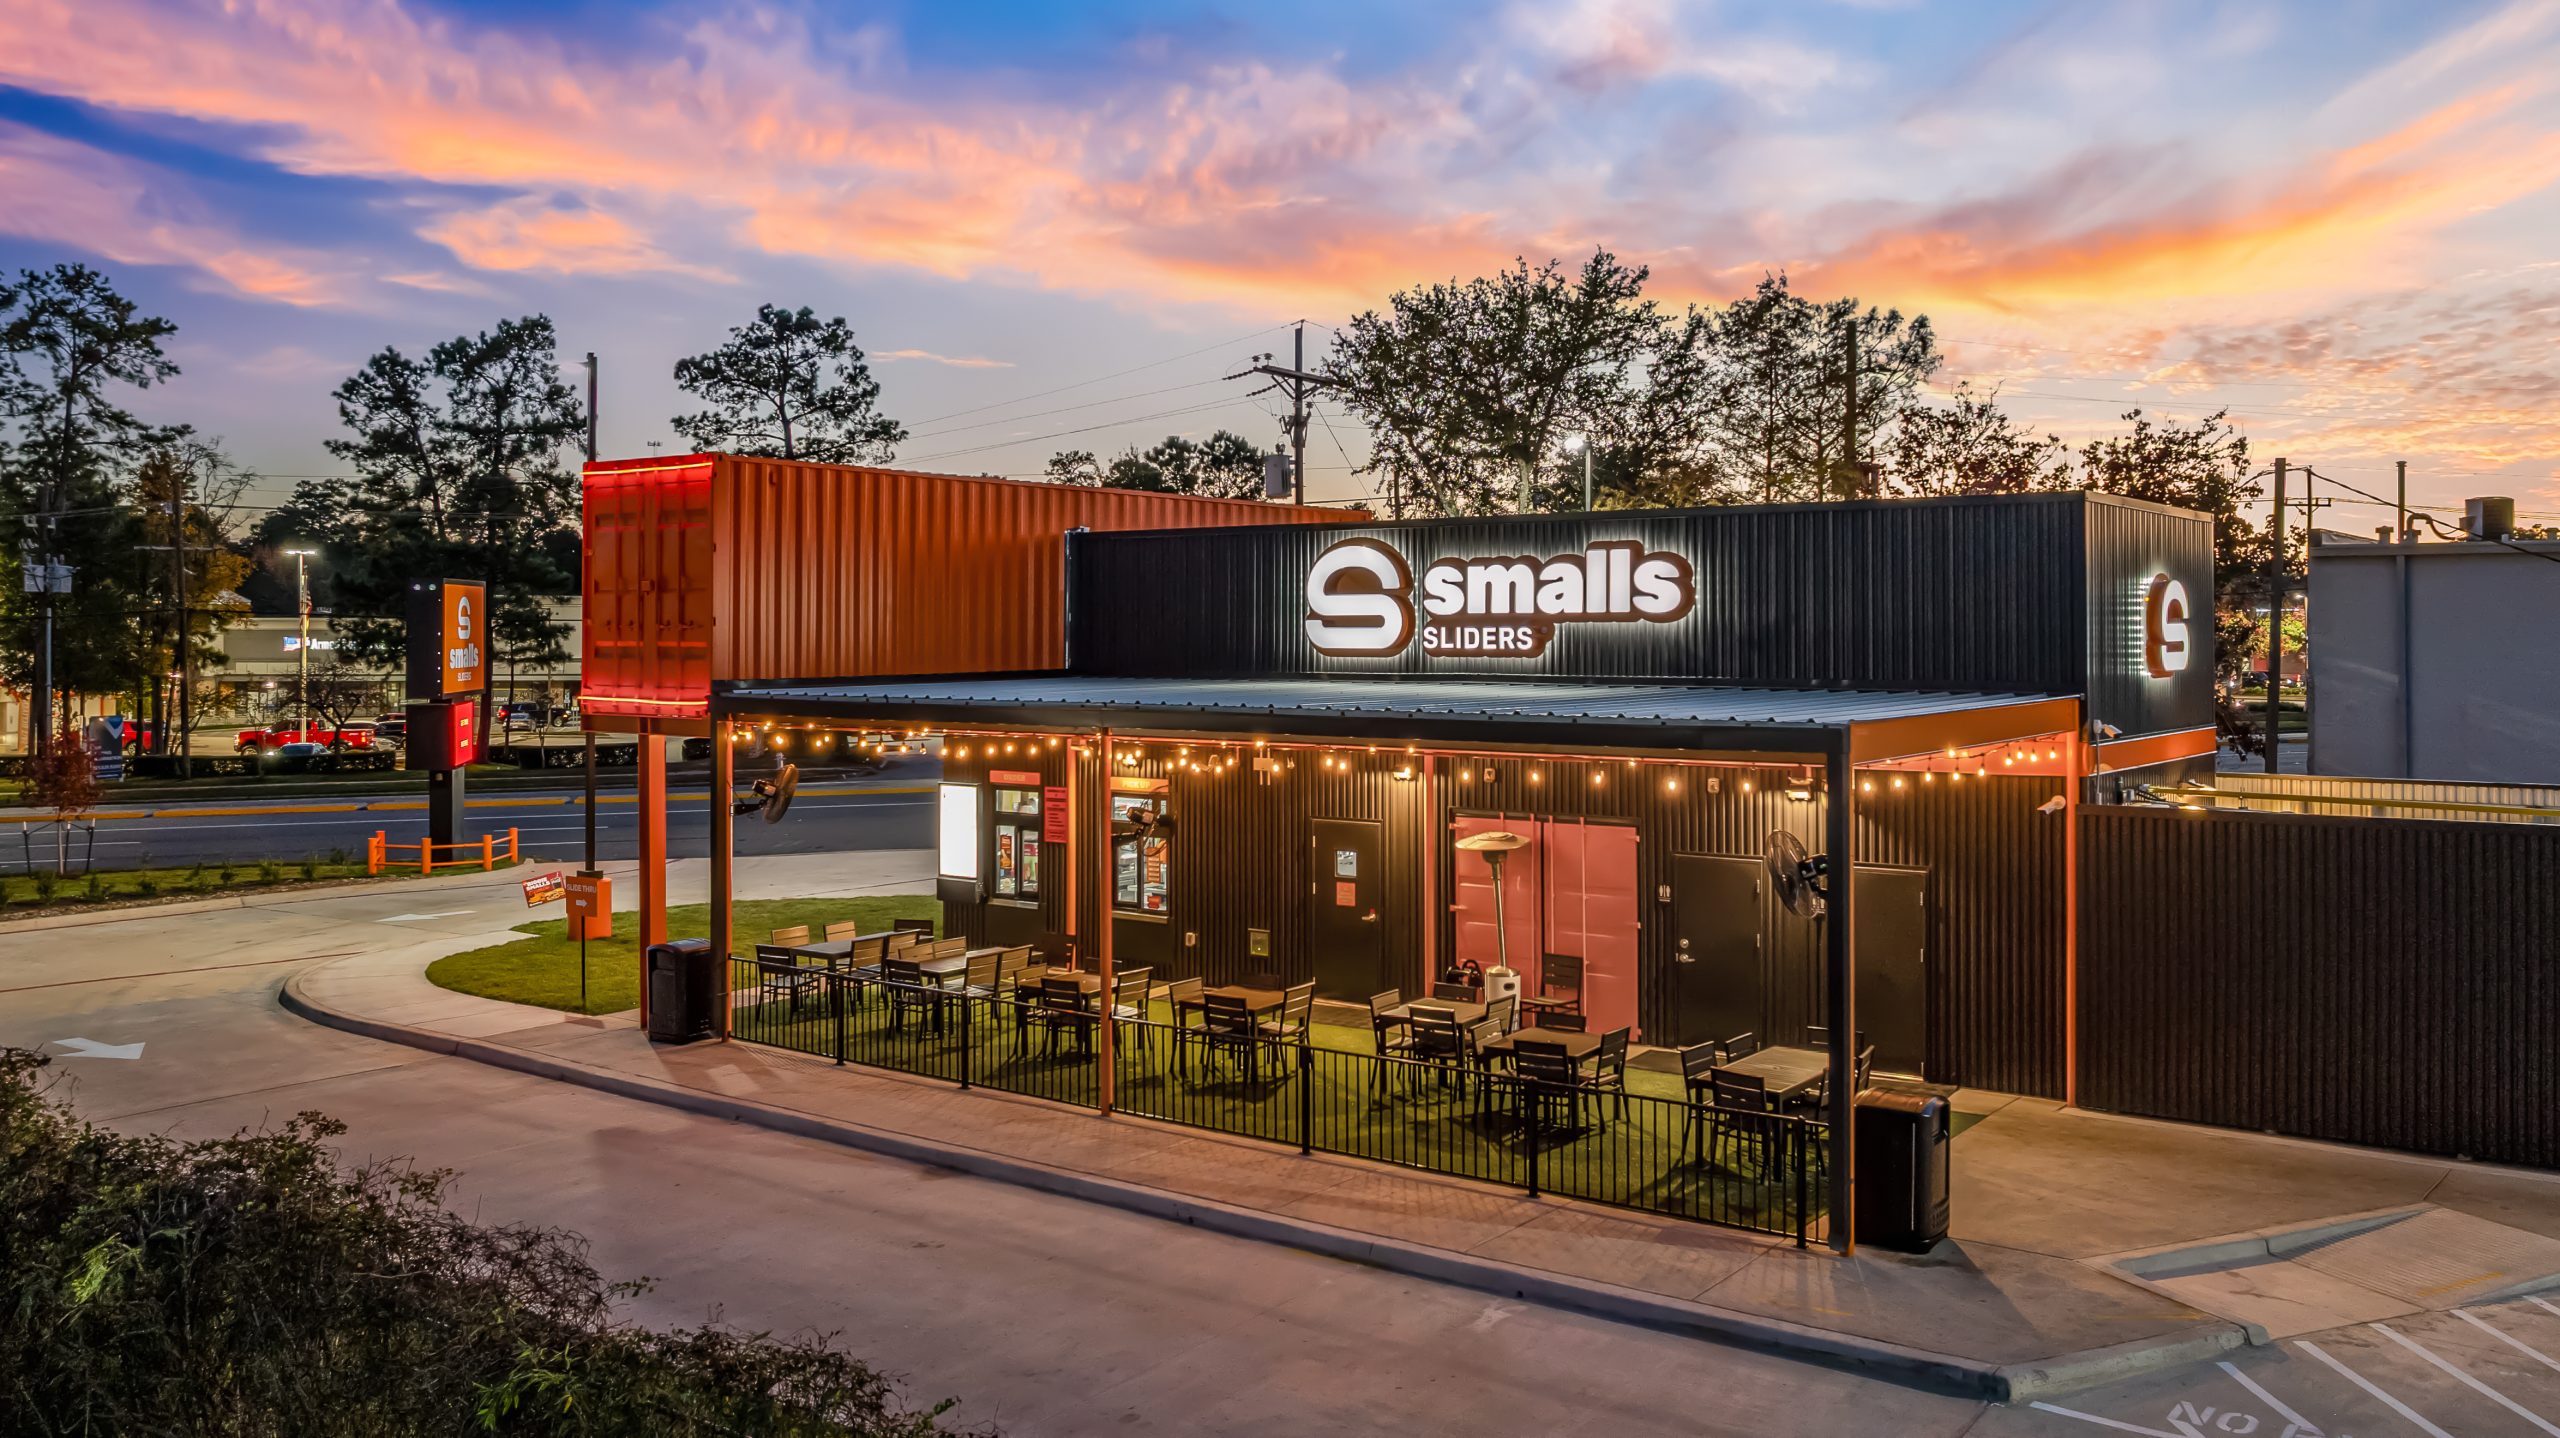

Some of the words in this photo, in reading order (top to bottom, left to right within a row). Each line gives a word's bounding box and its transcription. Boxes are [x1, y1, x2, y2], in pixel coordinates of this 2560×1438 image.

[1423, 548, 1682, 616] smalls
[1423, 625, 1534, 651] SLIDERS
[449, 643, 479, 669] smalls
[567, 884, 582, 892] SLIDE
[582, 885, 597, 894] THRU
[2166, 1400, 2260, 1434] NO
